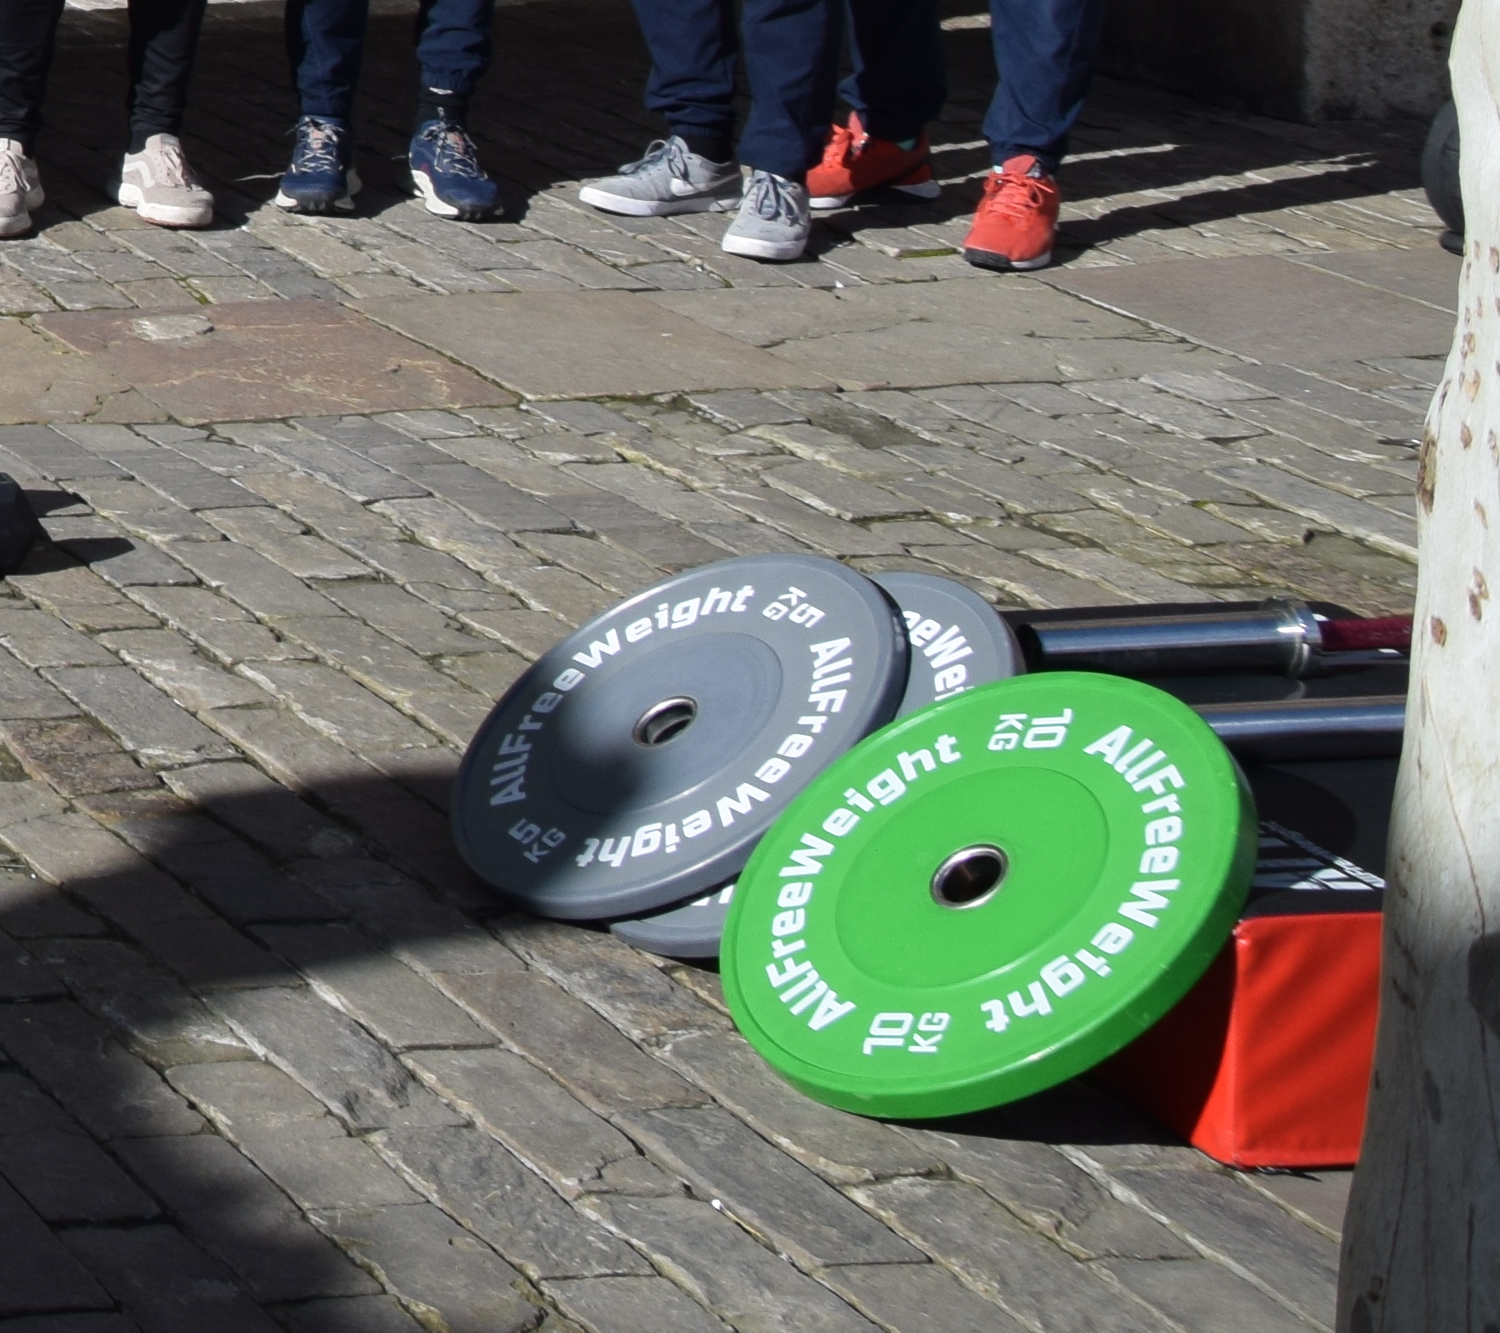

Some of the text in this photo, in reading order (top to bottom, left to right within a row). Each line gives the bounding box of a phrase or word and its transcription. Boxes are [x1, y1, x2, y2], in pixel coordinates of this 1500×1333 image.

[762, 586, 827, 629] 5 KG
[489, 583, 755, 807] AllFreeWeight
[576, 636, 855, 869] AllFreeWeight
[987, 707, 1072, 751] 10 KG
[508, 818, 567, 865] 5 KG
[765, 733, 962, 1032] AllFreeWeight
[980, 723, 1187, 1033] AllFreeWeight
[862, 1011, 952, 1055] 10 KG
